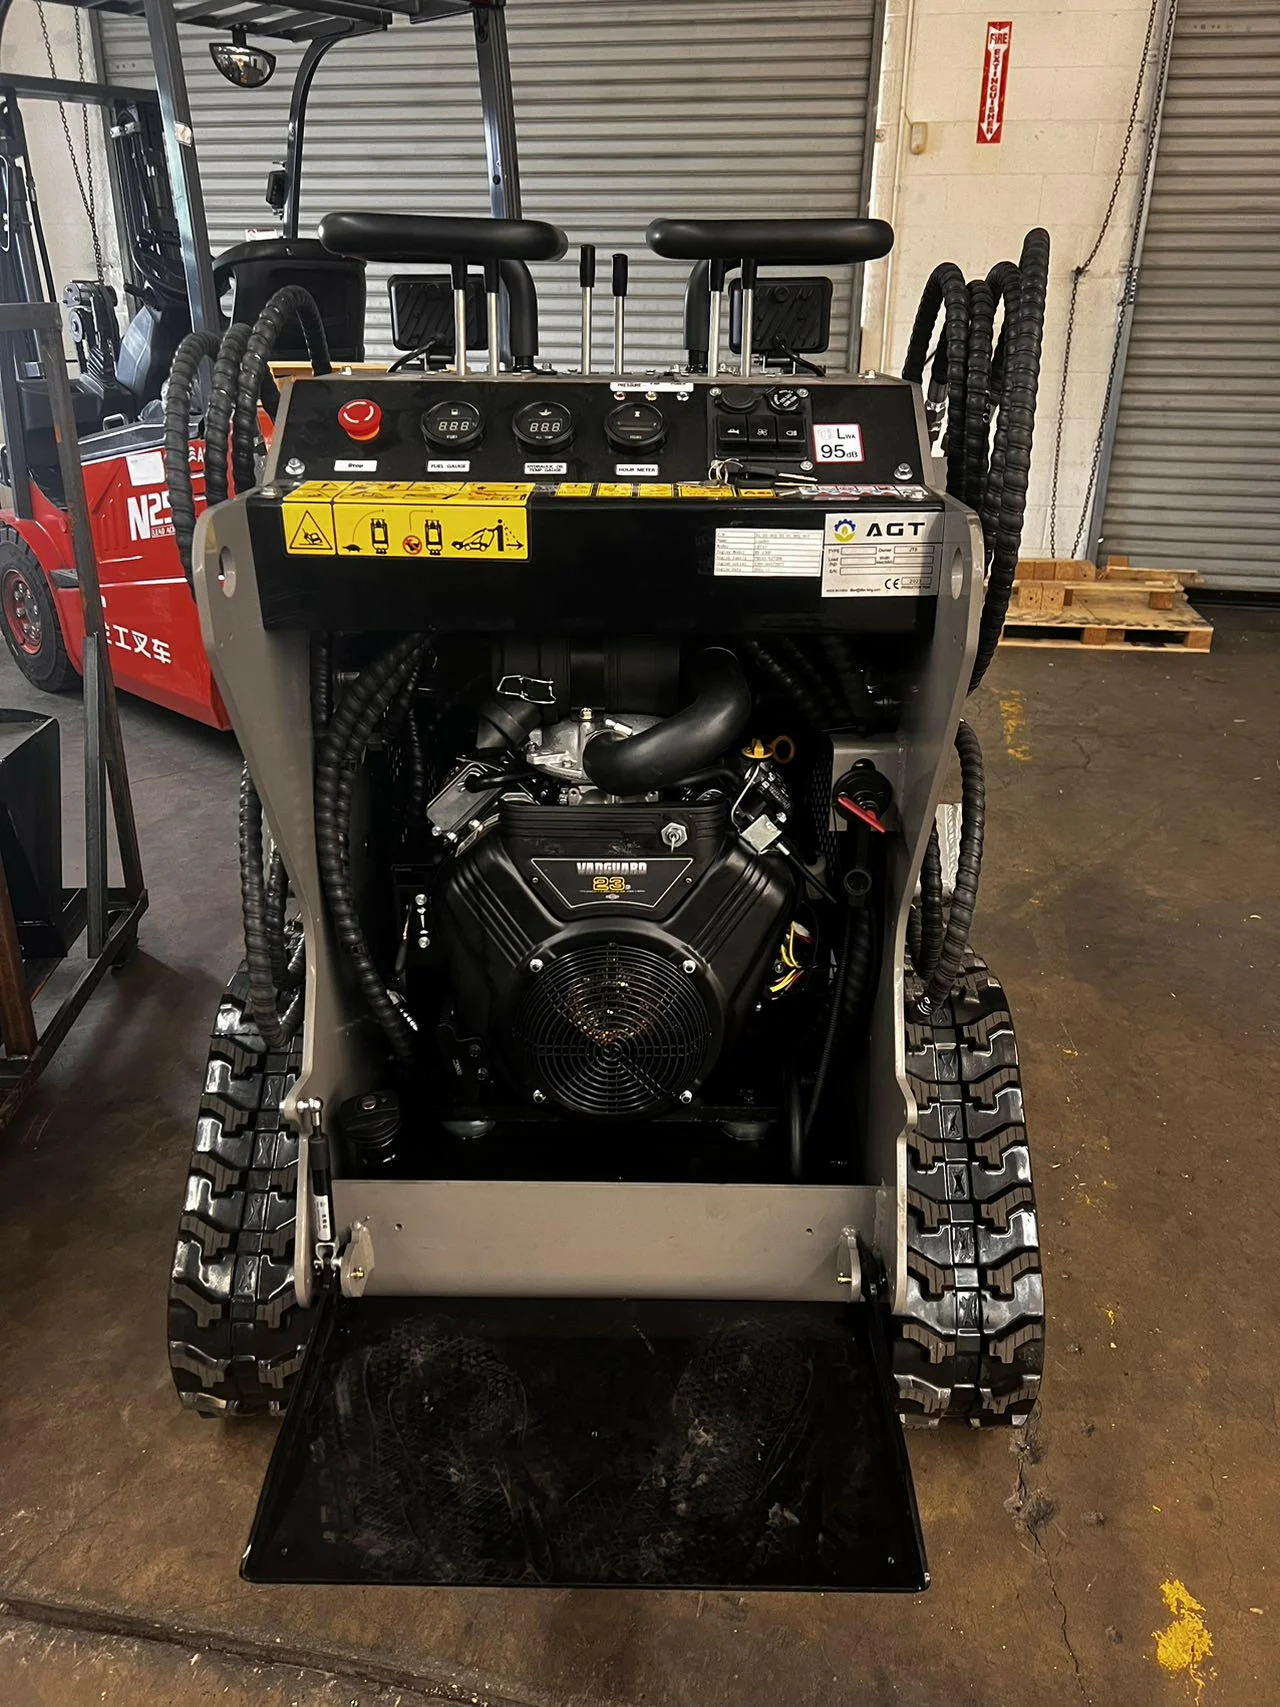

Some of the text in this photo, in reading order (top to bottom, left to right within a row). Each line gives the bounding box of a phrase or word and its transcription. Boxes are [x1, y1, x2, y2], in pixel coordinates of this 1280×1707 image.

[990, 33, 1008, 45] FIRE
[986, 48, 1001, 135] EXTINGUISHER
[866, 522, 926, 537] AGT
[576, 862, 648, 875] VANGUARD
